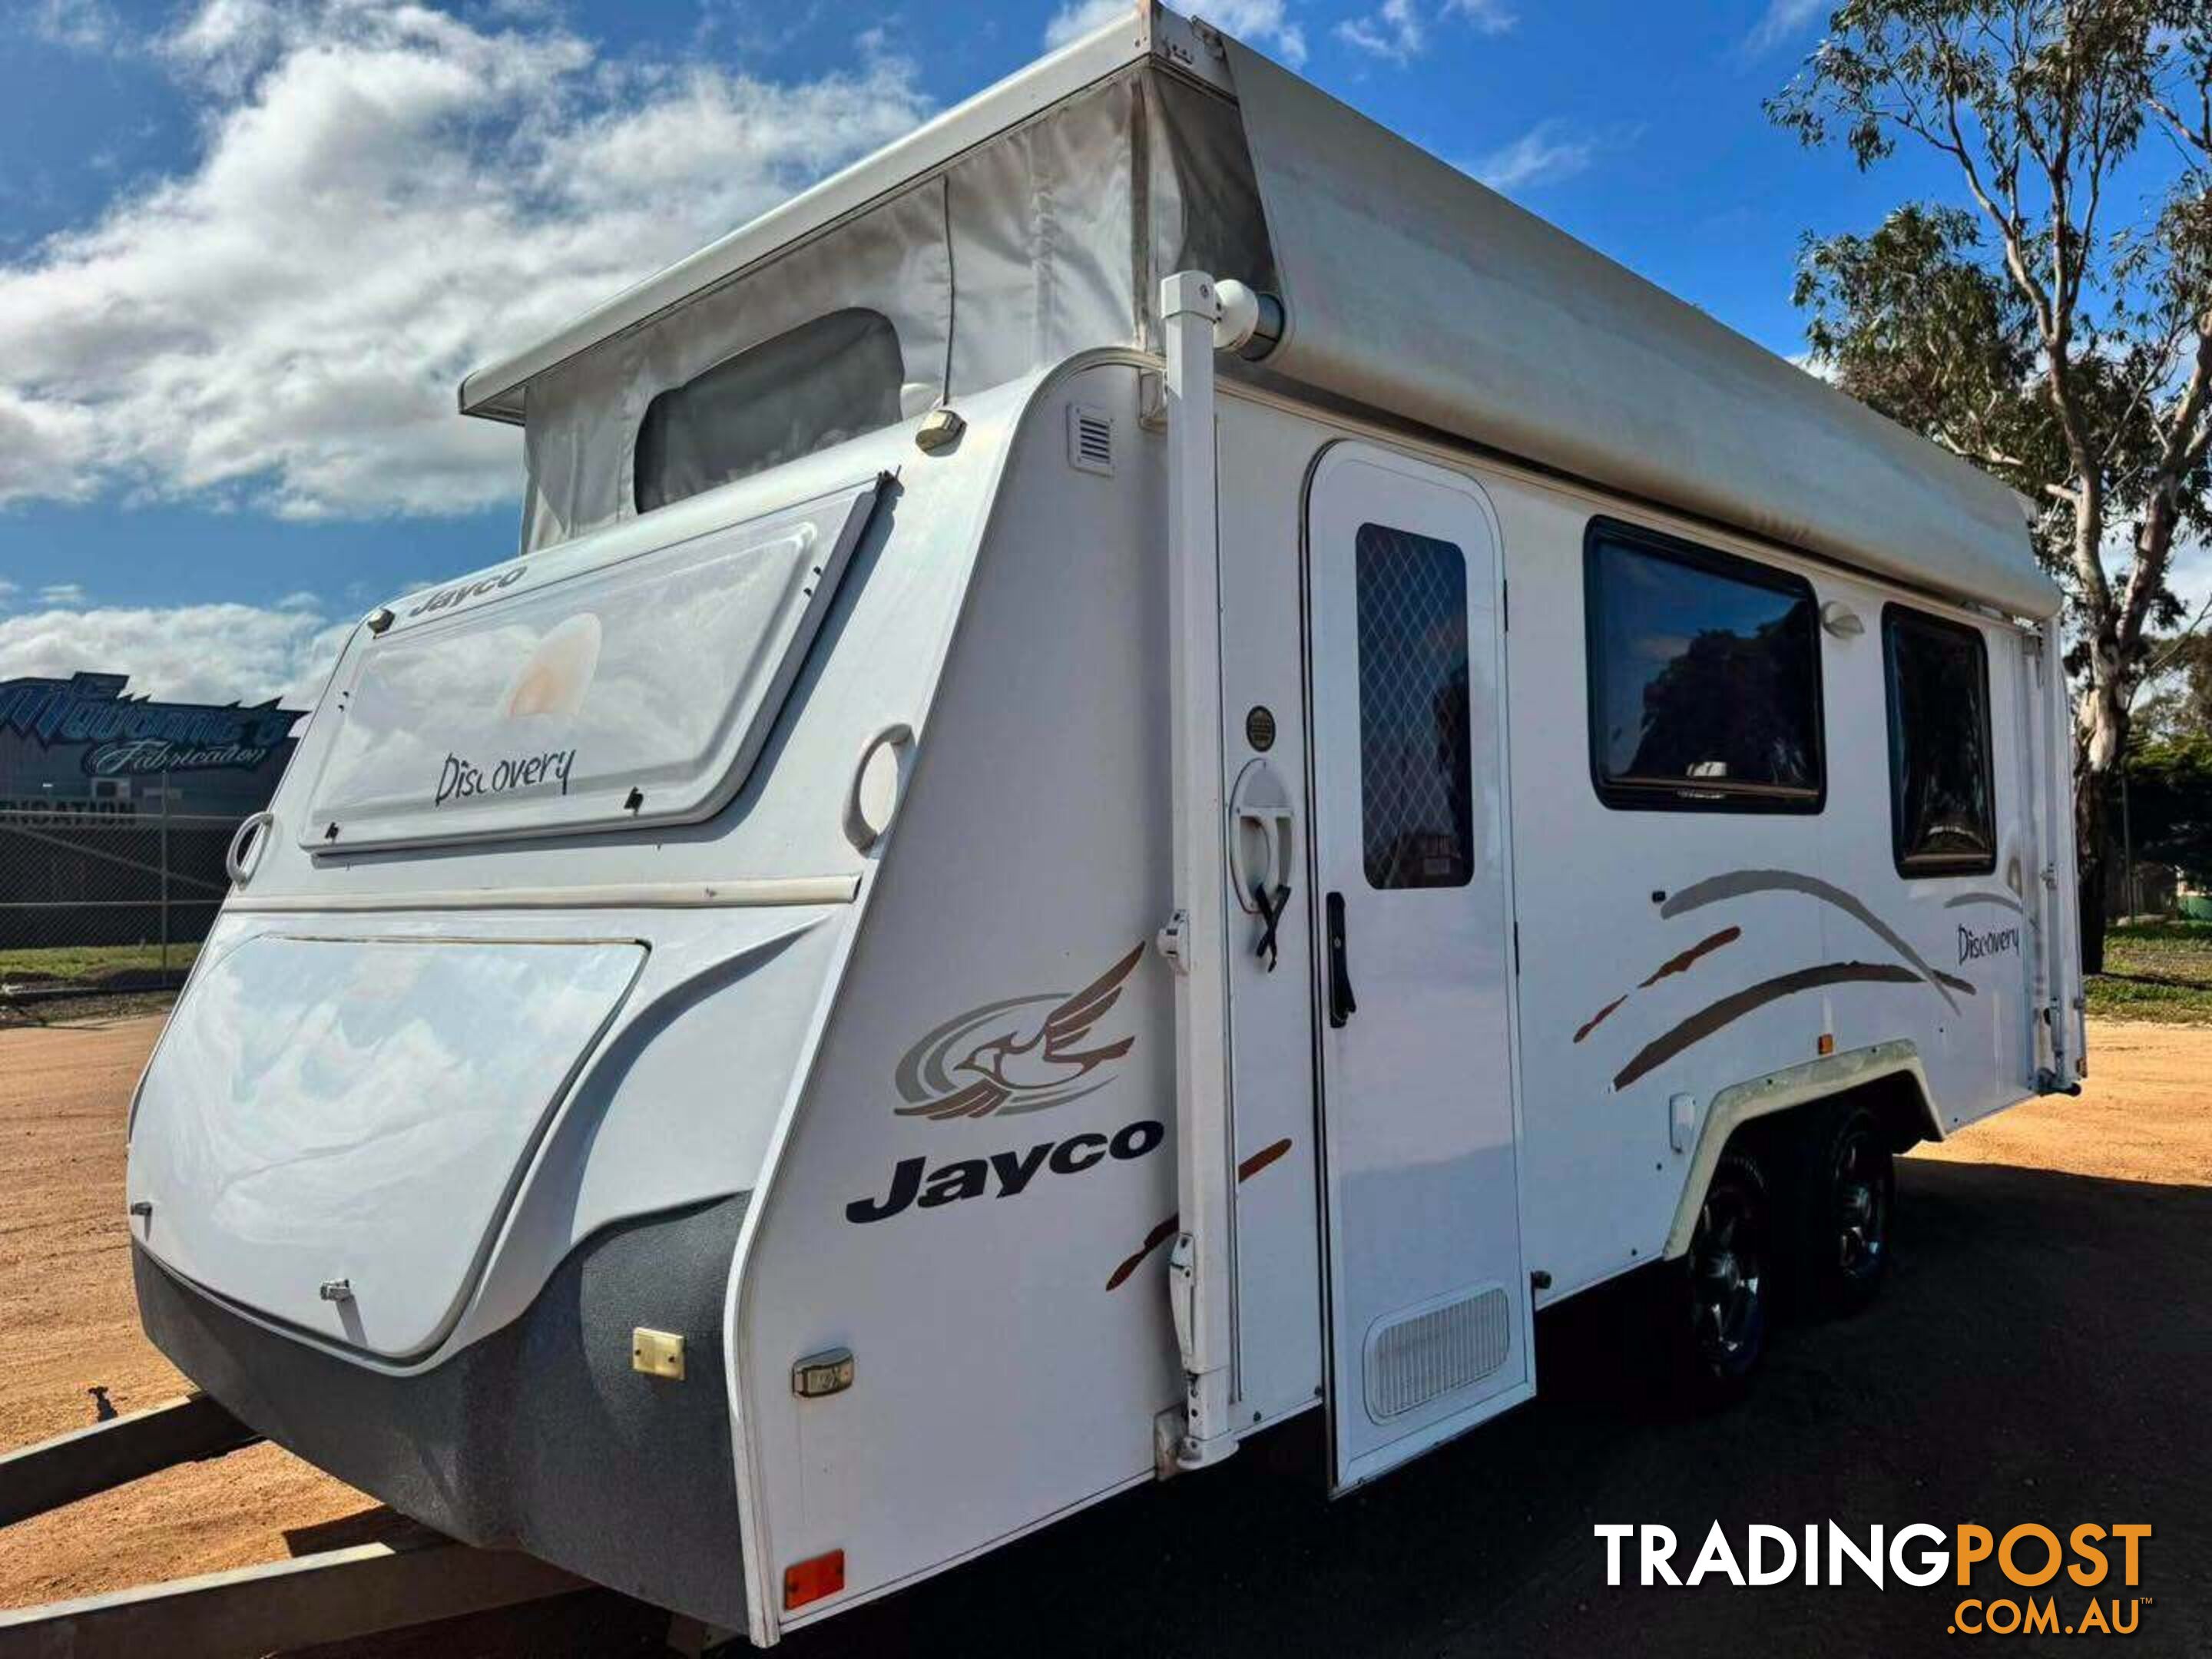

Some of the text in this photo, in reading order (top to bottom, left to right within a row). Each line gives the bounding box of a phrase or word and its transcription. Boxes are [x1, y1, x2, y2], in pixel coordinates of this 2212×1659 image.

[409, 566, 528, 616] Jayco
[435, 749, 576, 807] Discovery
[1957, 922, 2019, 966] Discovery
[846, 1120, 1165, 1224] Jayco
